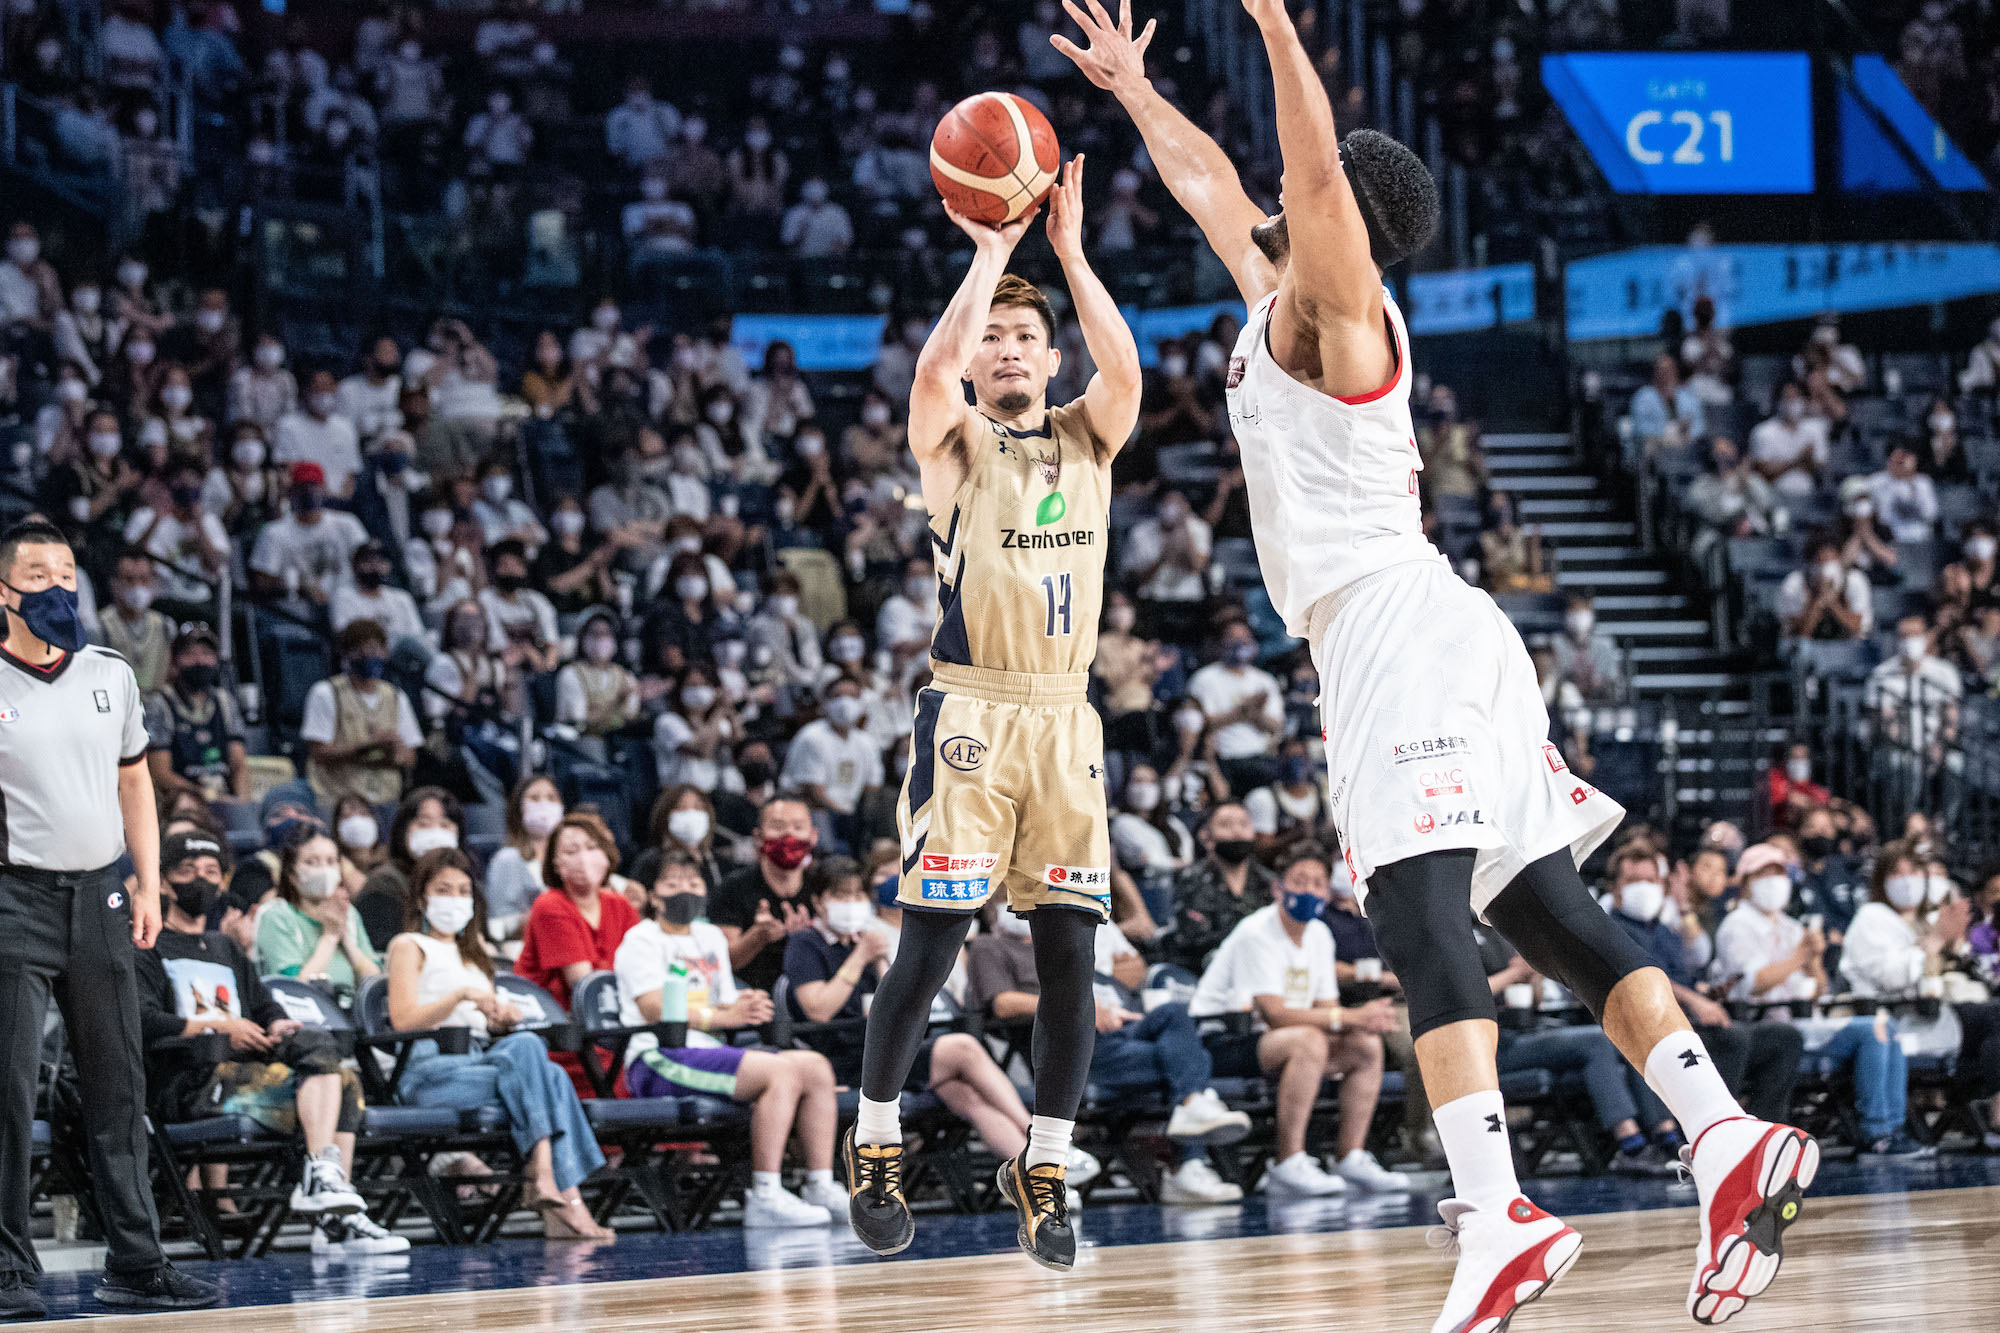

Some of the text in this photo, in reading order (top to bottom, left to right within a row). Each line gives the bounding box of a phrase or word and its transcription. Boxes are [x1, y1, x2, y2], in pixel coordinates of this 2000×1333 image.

[1626, 110, 1733, 165] C21
[1040, 572, 1072, 637] 14
[950, 743, 982, 764] AE
[1419, 769, 1464, 788] CMC
[1440, 810, 1485, 827] JAL
